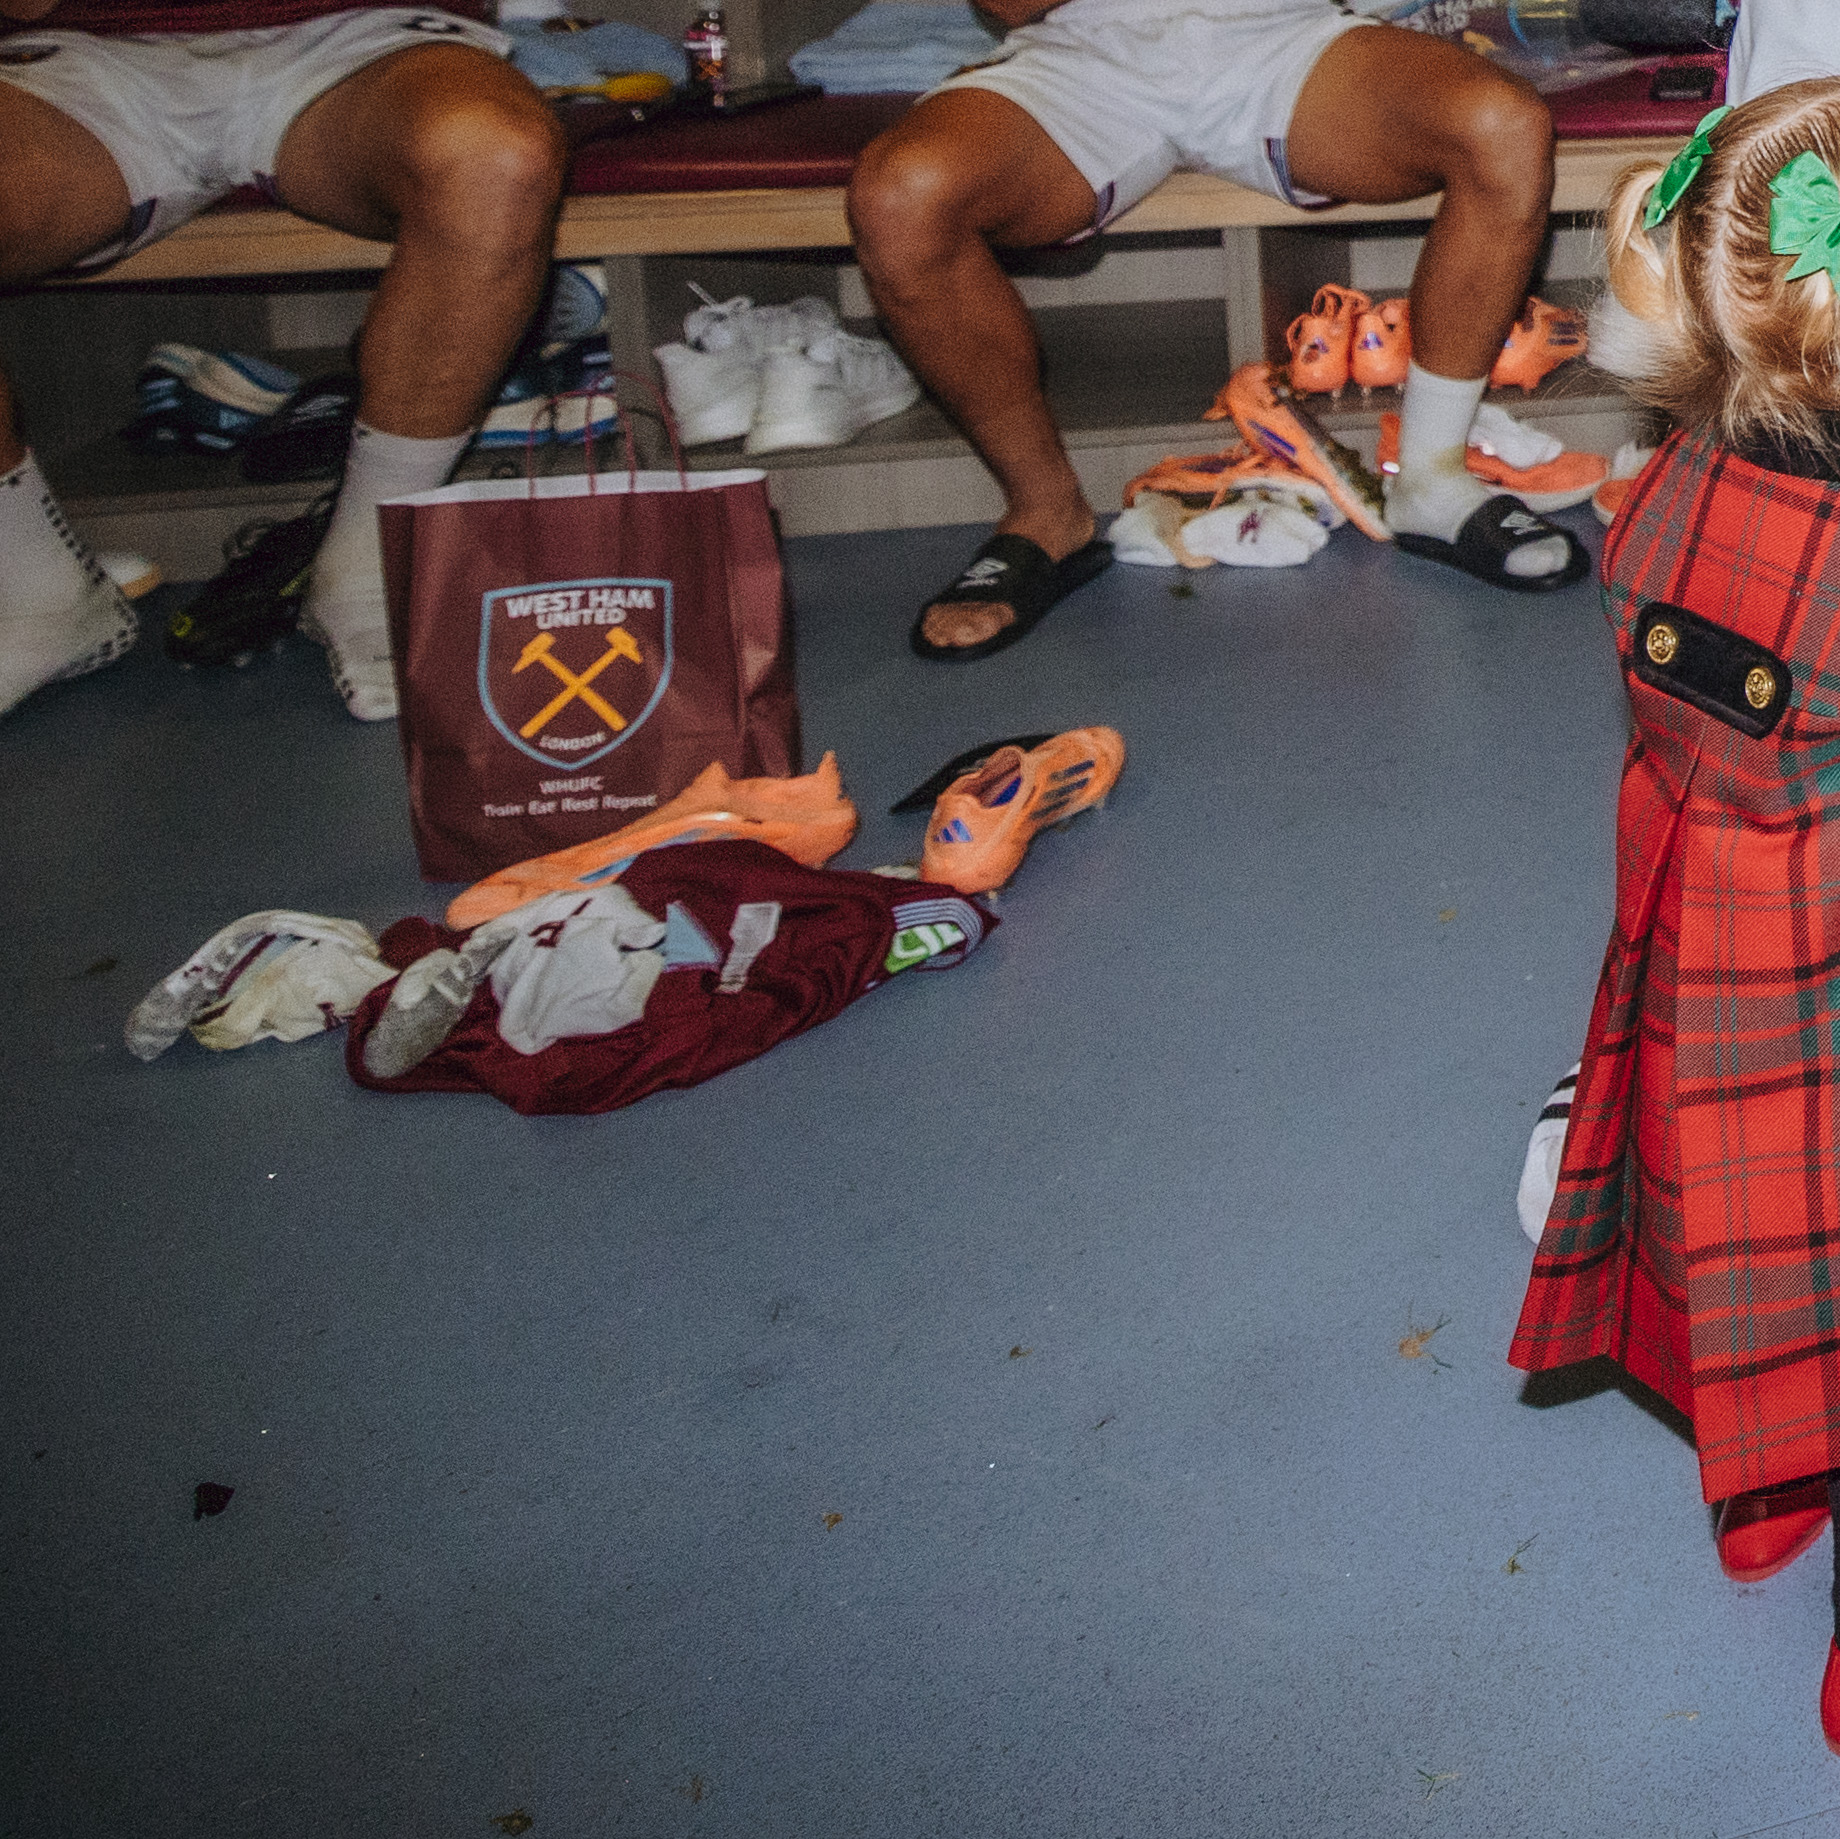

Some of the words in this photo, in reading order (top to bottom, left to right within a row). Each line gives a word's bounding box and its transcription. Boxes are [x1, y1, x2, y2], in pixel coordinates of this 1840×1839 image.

[505, 590, 586, 619] WEST
[588, 588, 656, 610] HAM
[536, 607, 627, 630] UNITED
[539, 731, 606, 751] LONDON
